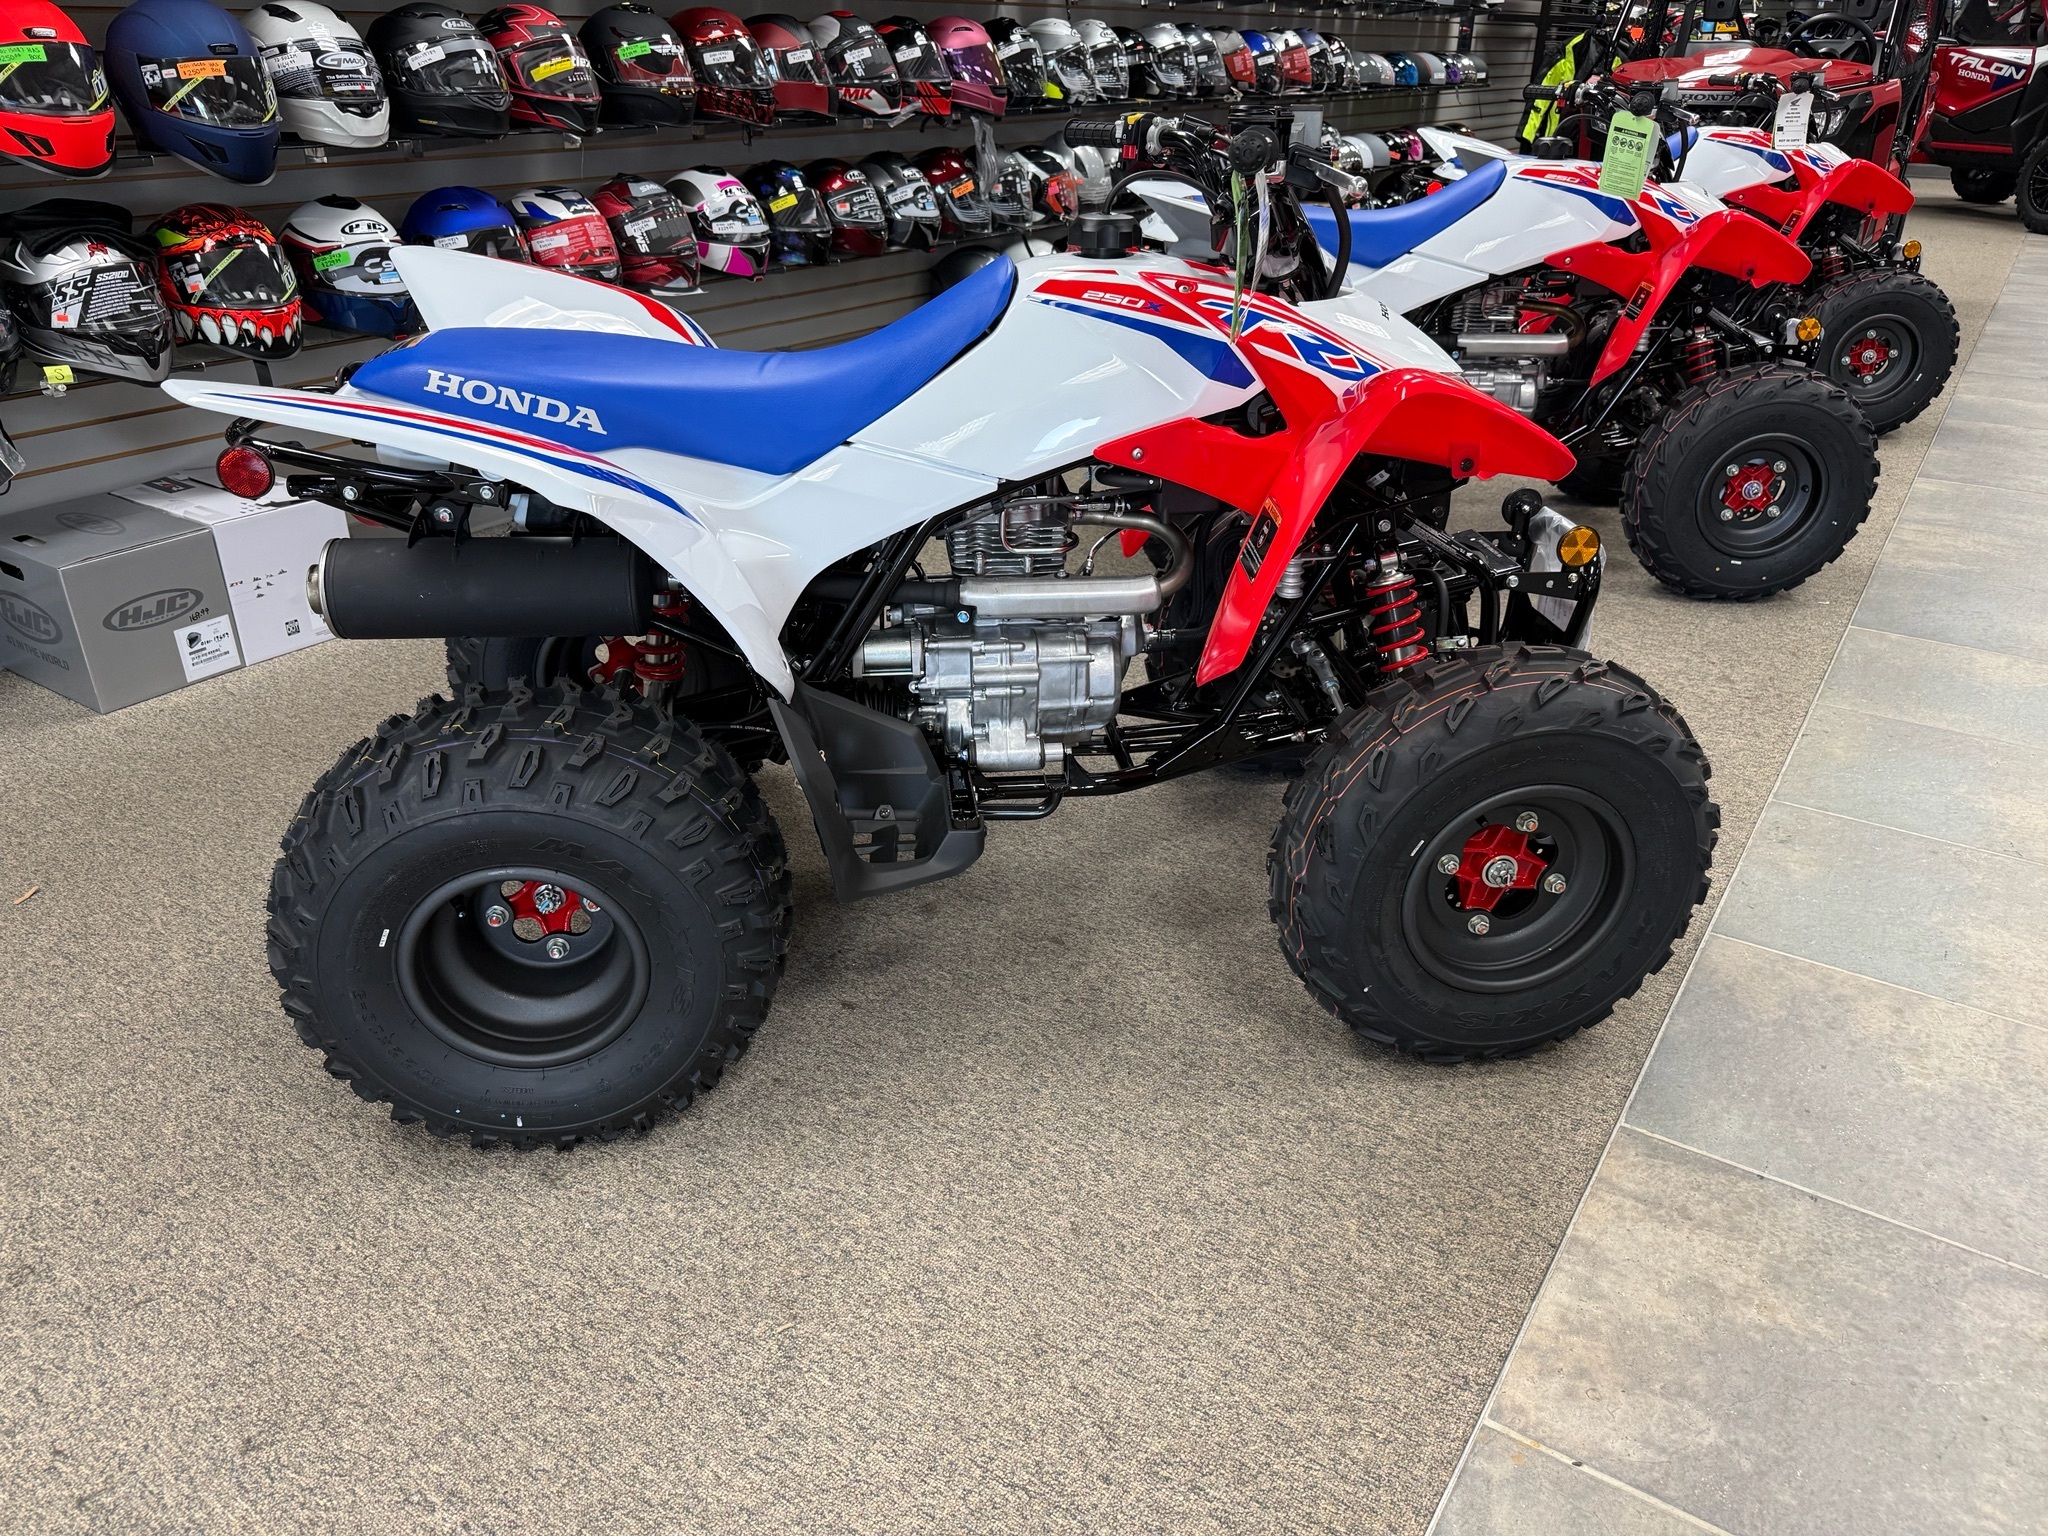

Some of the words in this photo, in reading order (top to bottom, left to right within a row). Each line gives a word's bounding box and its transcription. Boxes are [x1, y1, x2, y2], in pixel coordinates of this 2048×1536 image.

[447, 21, 472, 29] HJC
[1949, 51, 2026, 80] TALON
[1958, 69, 1990, 83] HONDA
[95, 270, 129, 282] SS2100
[1082, 289, 1162, 313] 250X
[54, 368, 64, 380] S
[423, 369, 608, 435] HONDA
[1, 597, 51, 637] HJC
[118, 592, 190, 628] HJC
[40, 652, 70, 671] WORLD
